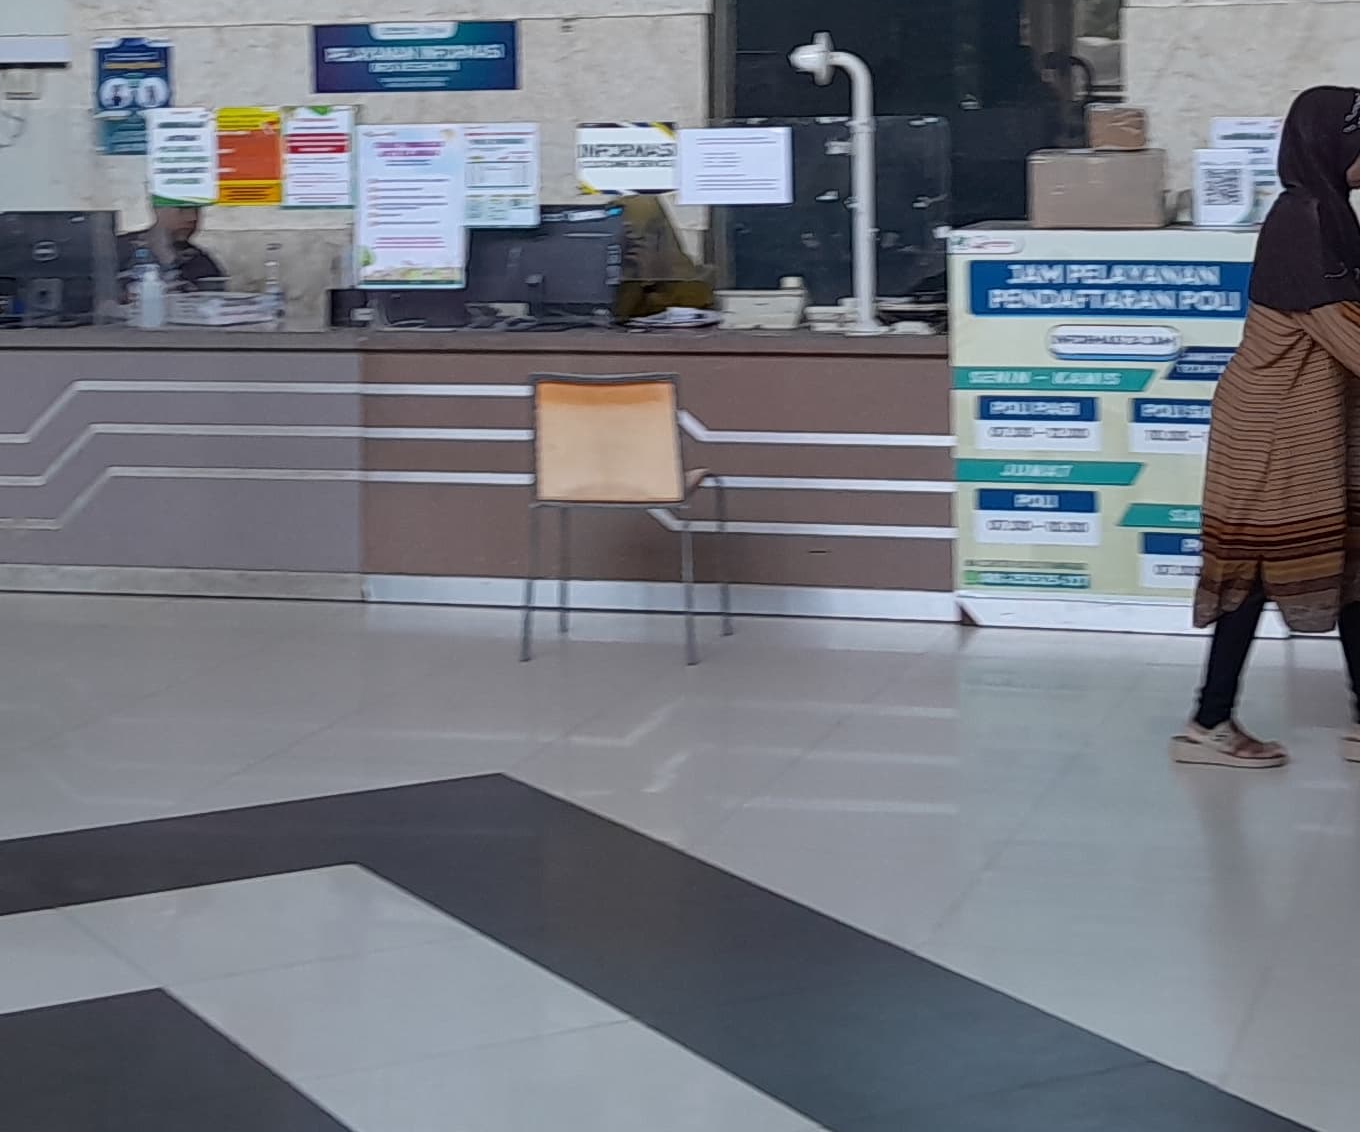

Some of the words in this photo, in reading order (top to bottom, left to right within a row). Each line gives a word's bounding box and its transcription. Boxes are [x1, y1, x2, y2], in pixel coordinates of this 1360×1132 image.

[1006, 264, 1064, 284] JAM
[1066, 264, 1220, 285] PELAYANAN
[988, 289, 1177, 309] PENDAFTARAN
[1179, 290, 1240, 311] POLI
